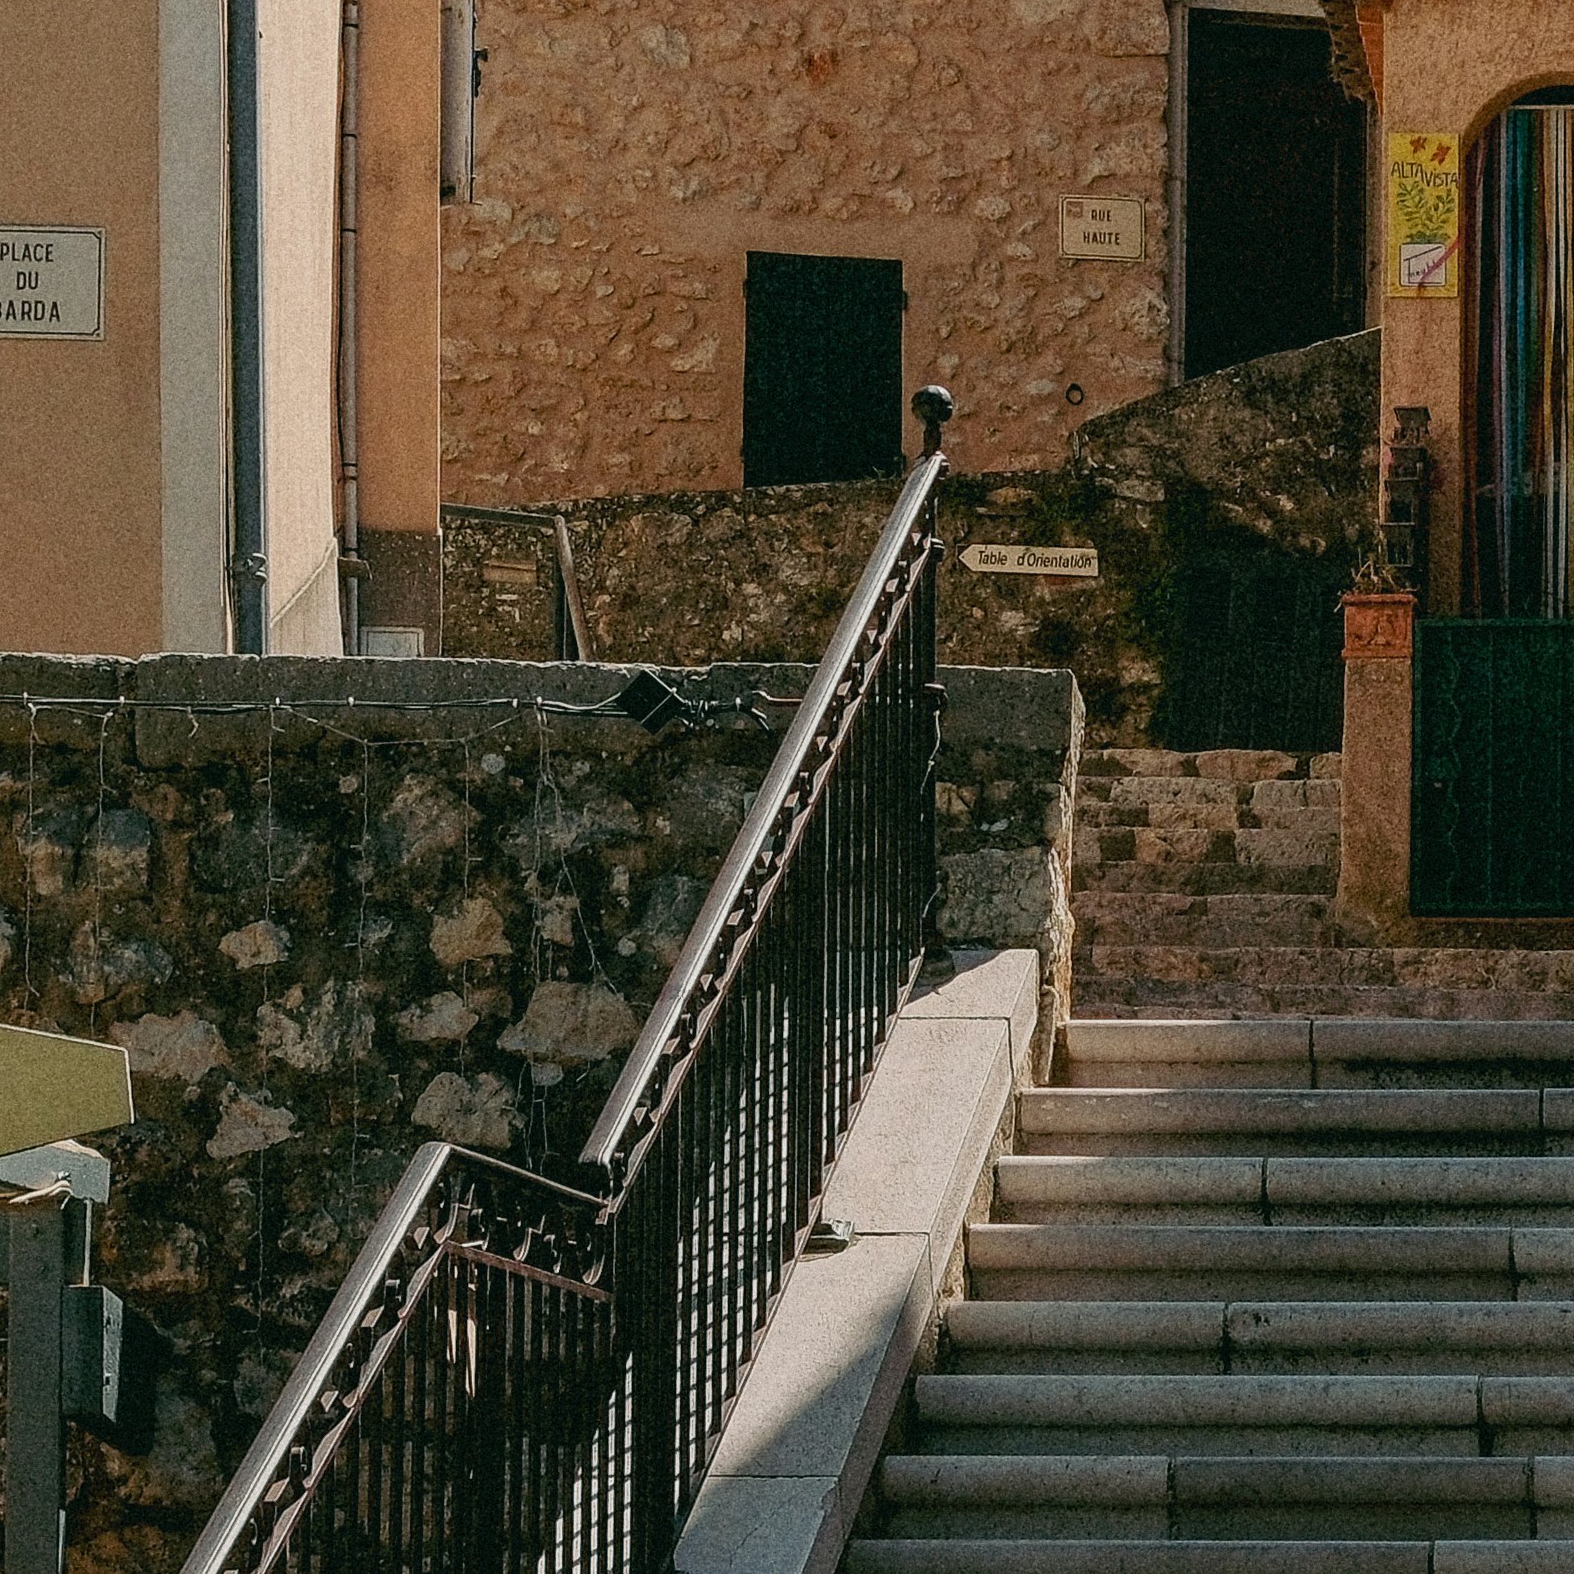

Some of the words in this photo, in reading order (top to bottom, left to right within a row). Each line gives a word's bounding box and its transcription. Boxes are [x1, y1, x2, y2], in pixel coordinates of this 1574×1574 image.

[1390, 161, 1424, 184] ALTA
[1424, 169, 1459, 189] VISTA
[1090, 209, 1112, 222] RUE
[1082, 231, 1121, 246] HAUTE
[0, 242, 54, 263] PLACE
[16, 271, 39, 290] DU
[977, 549, 1008, 565] Table
